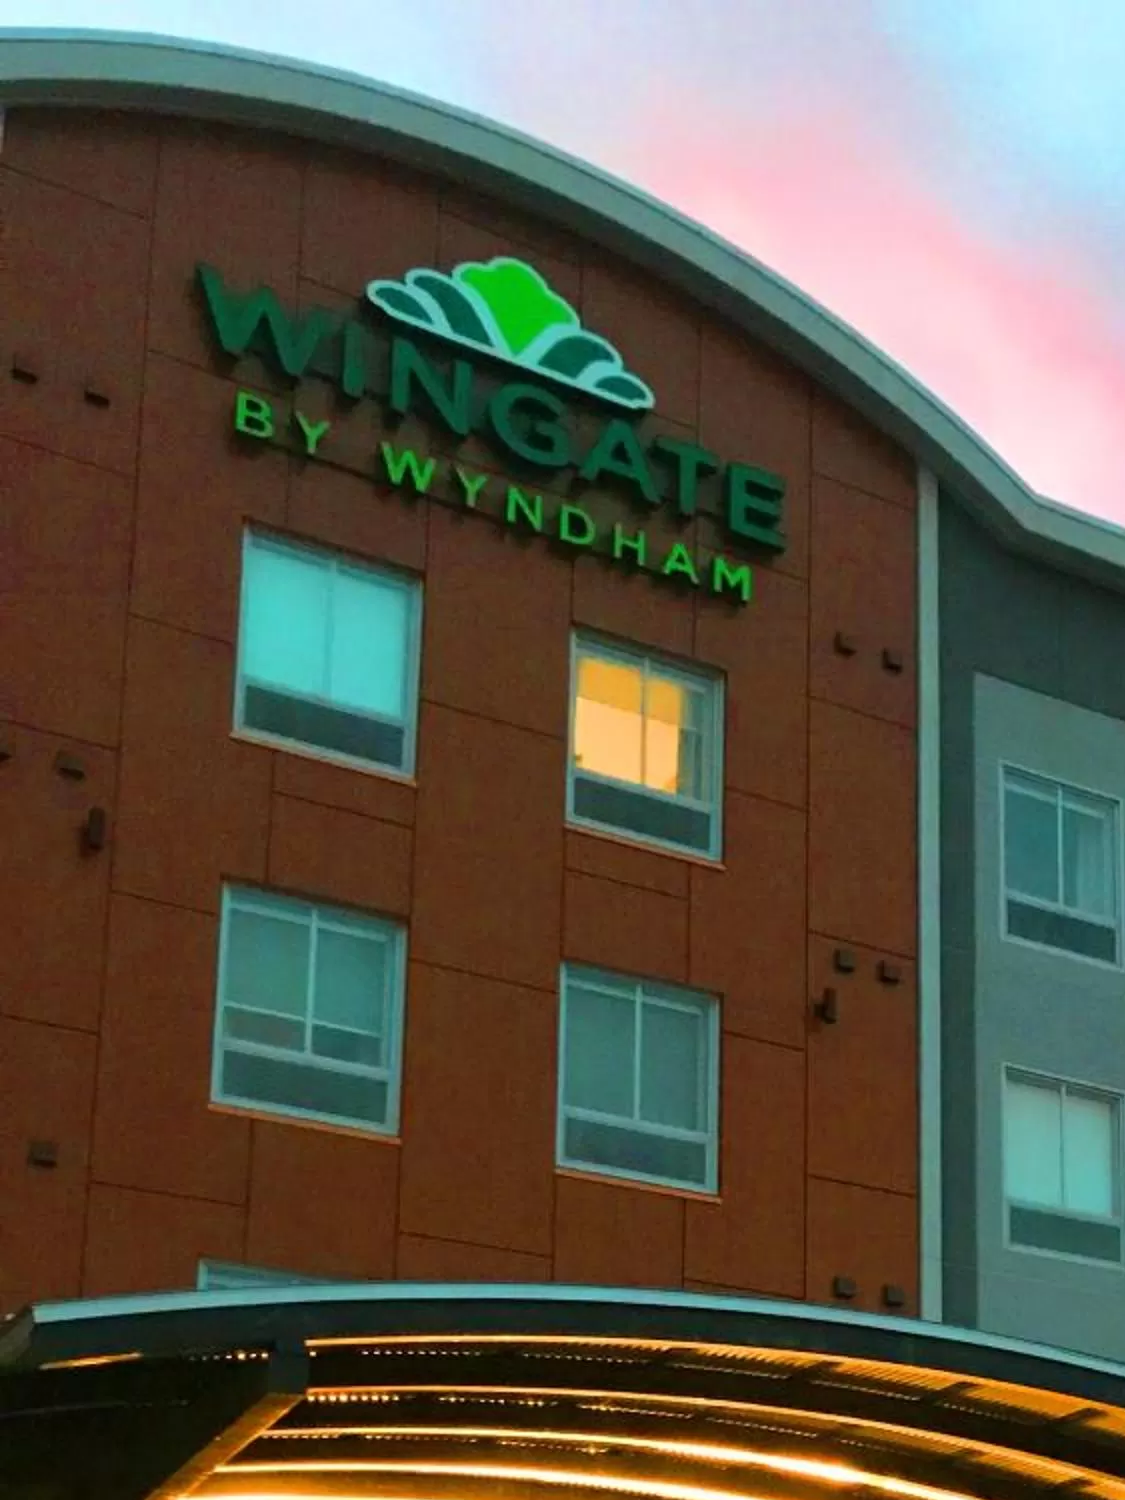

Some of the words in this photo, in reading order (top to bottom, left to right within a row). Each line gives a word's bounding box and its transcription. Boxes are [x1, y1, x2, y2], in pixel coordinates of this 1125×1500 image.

[194, 262, 784, 550] WINGATE
[235, 390, 329, 454] BY
[381, 441, 753, 601] WYNDHAM
